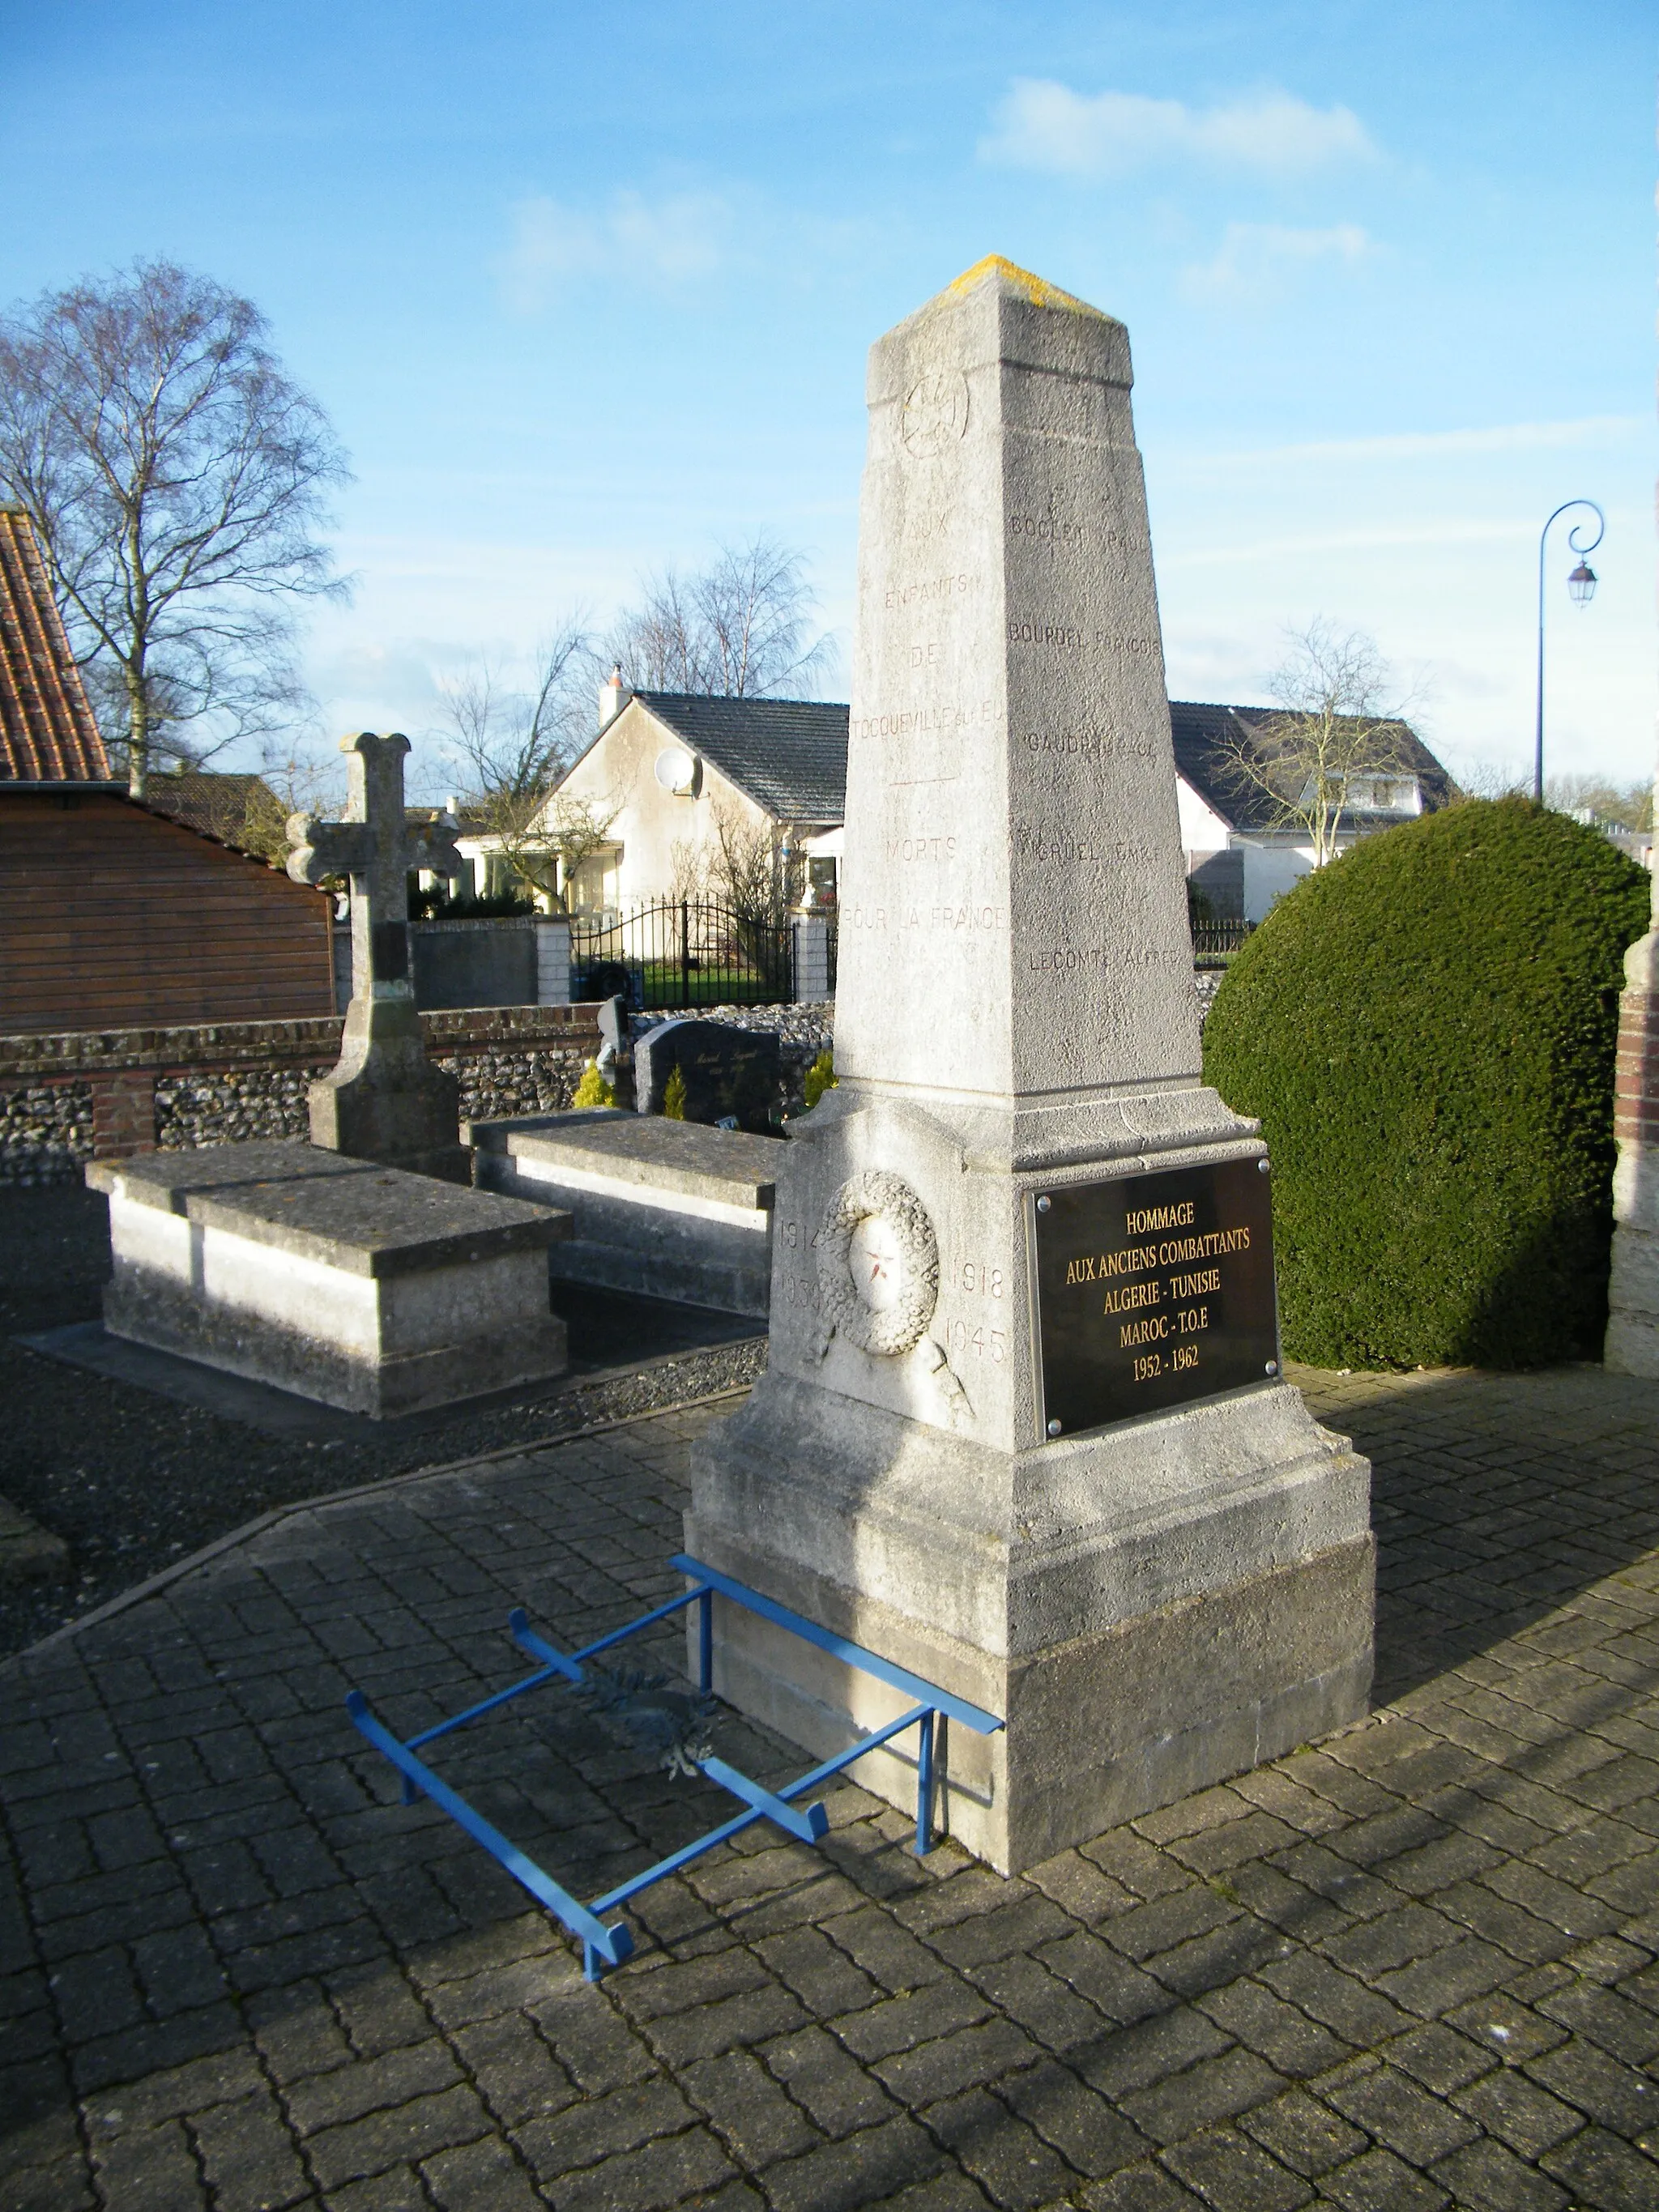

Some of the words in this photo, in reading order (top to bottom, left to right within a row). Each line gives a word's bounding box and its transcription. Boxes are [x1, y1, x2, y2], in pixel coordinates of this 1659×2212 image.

[908, 514, 948, 539] AUX
[885, 573, 967, 609] ENFANTS
[1009, 622, 1086, 649] BOURDEL
[910, 643, 939, 668] DE
[853, 705, 950, 739] TOCQUEVILLE
[982, 699, 1003, 722] EU
[885, 837, 957, 862] MORTS
[844, 907, 886, 931] POUR
[899, 907, 921, 931] LA
[932, 906, 1004, 931] FRANCE
[1126, 1203, 1194, 1235] HOMMAGE
[1065, 1257, 1096, 1285] AUX
[1098, 1245, 1157, 1278] ANCIENS
[1159, 1227, 1251, 1265] COMBATTANTS
[952, 1262, 1004, 1300] 1918
[1103, 1281, 1160, 1315] ALGERIE
[1170, 1268, 1221, 1299] TUNISIE
[945, 1316, 1006, 1364] 1945
[1120, 1315, 1170, 1348] MAROC
[1132, 1353, 1161, 1383] 1952
[1172, 1345, 1199, 1372] 1962
